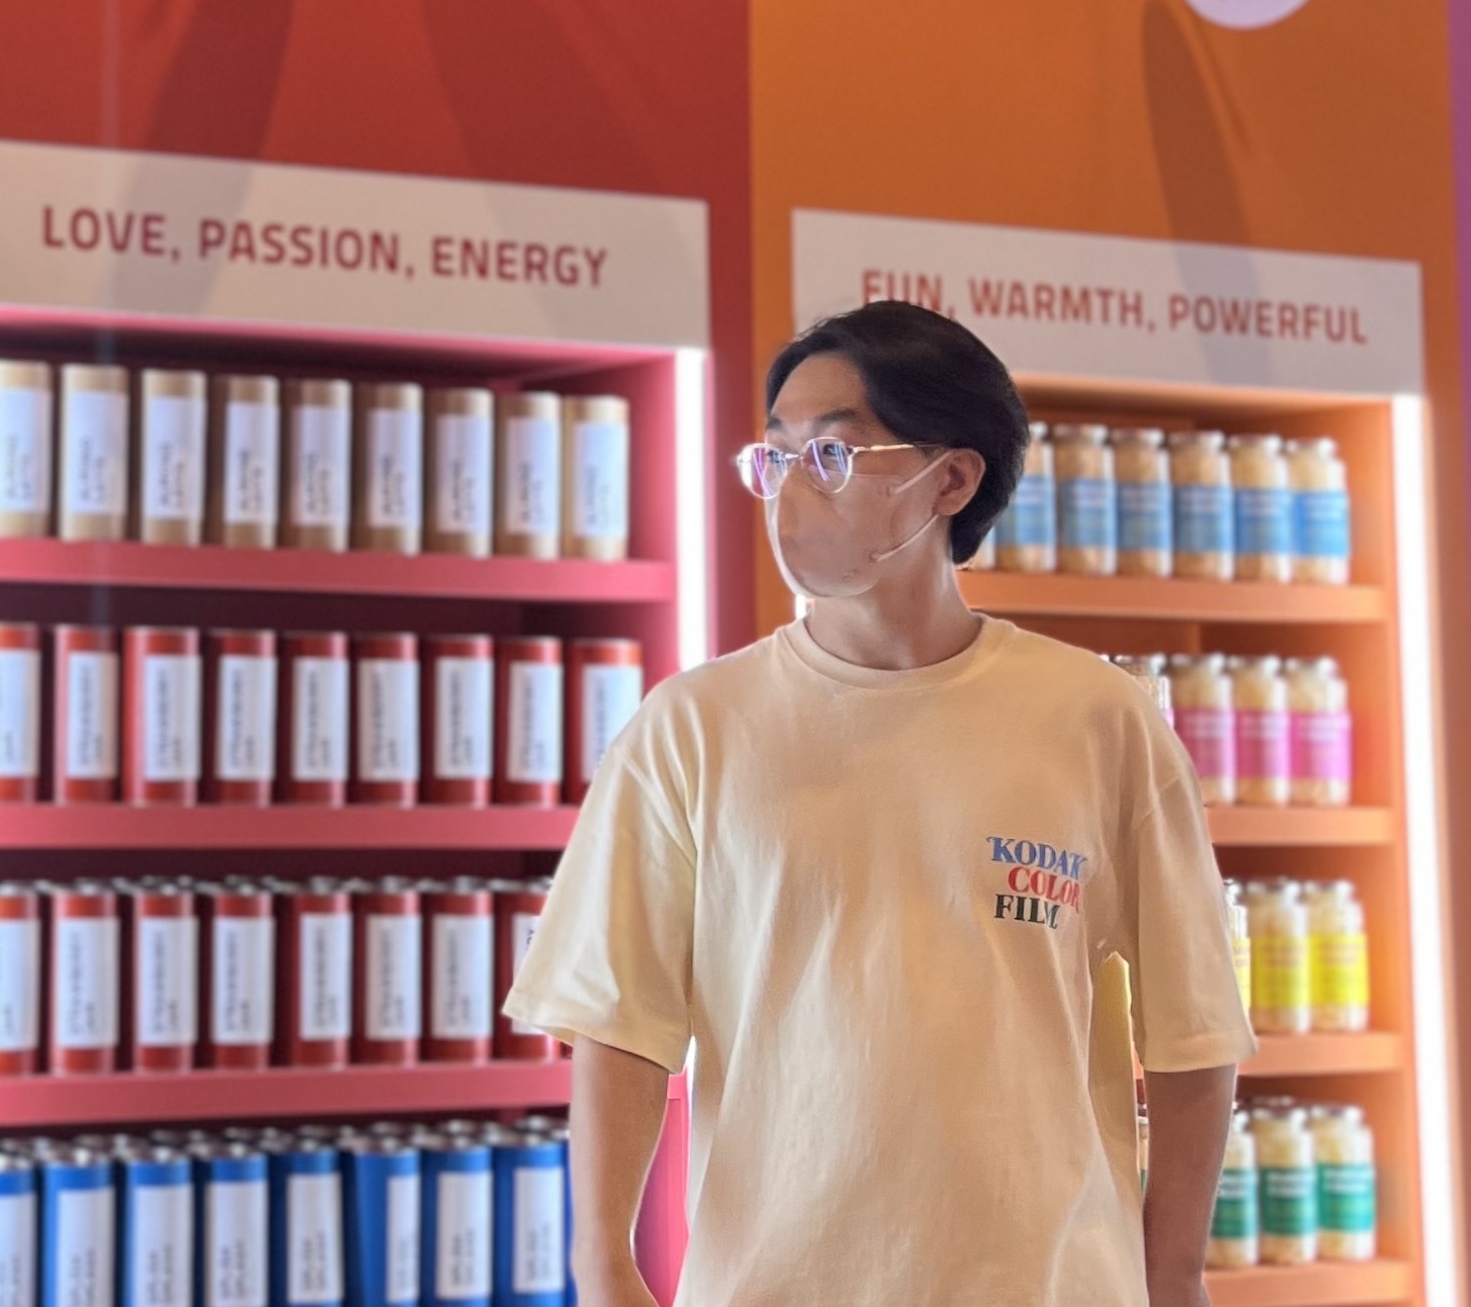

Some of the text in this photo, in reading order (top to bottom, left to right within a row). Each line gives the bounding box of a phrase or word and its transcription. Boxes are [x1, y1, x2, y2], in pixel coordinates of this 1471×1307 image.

[42, 205, 607, 287] LOVE, PASSION, ENERGY
[968, 277, 1156, 333] WARMTH,
[1168, 294, 1367, 345] POWERFUL
[986, 836, 1088, 881] KODAK
